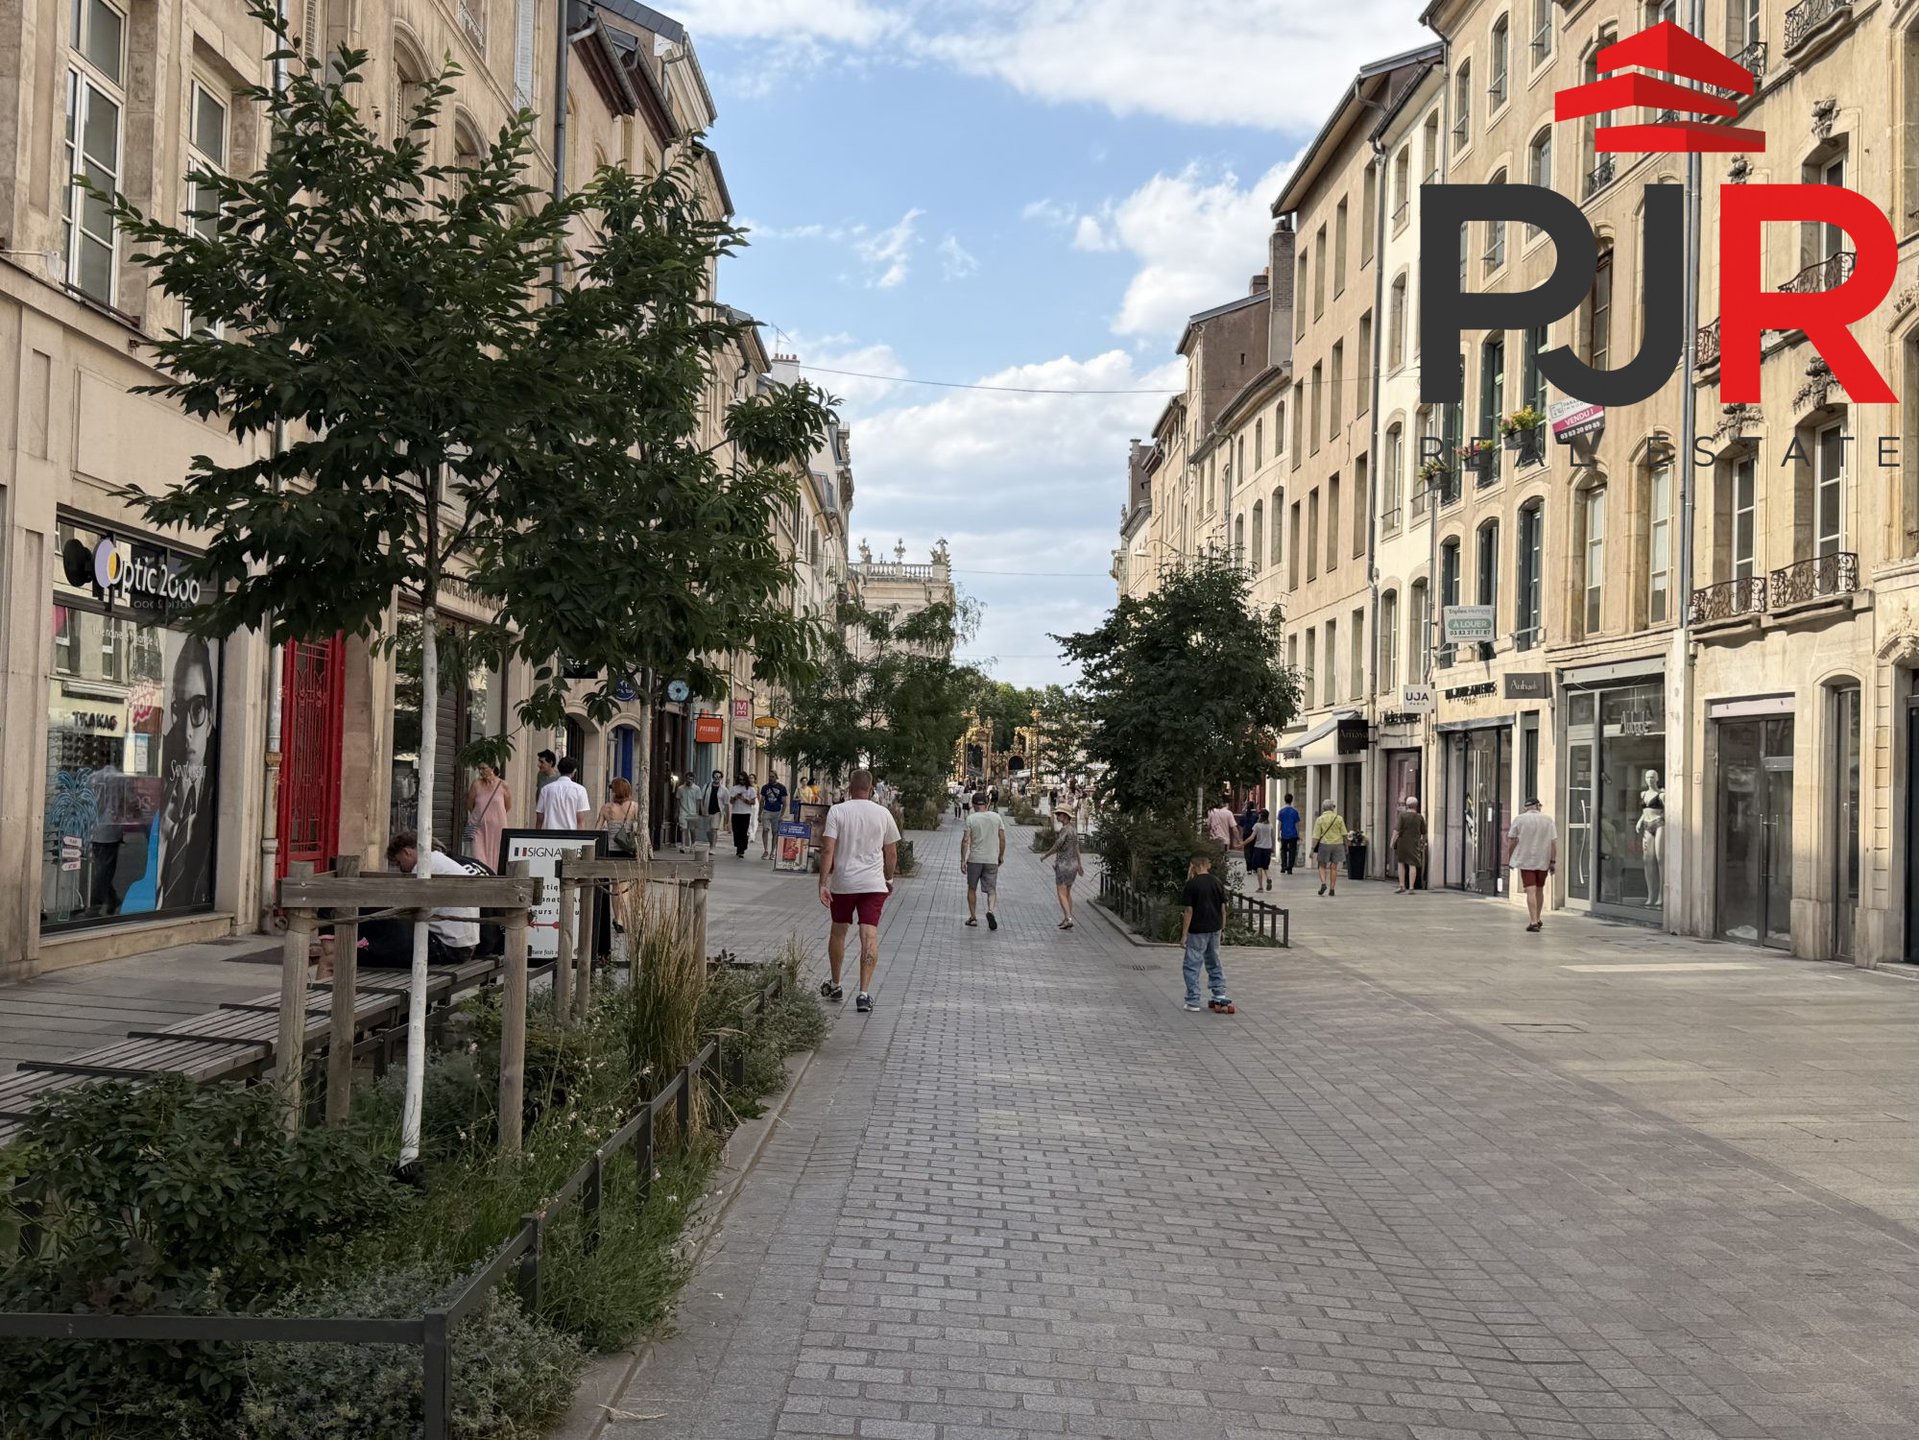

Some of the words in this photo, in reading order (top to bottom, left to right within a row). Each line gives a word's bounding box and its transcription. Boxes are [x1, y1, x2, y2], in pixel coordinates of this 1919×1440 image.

[1565, 411, 1590, 425] VENDU
[107, 547, 158, 595] Optic
[159, 563, 201, 604] 2000
[1460, 620, 1488, 628] LOUER
[1405, 692, 1430, 702] UJA
